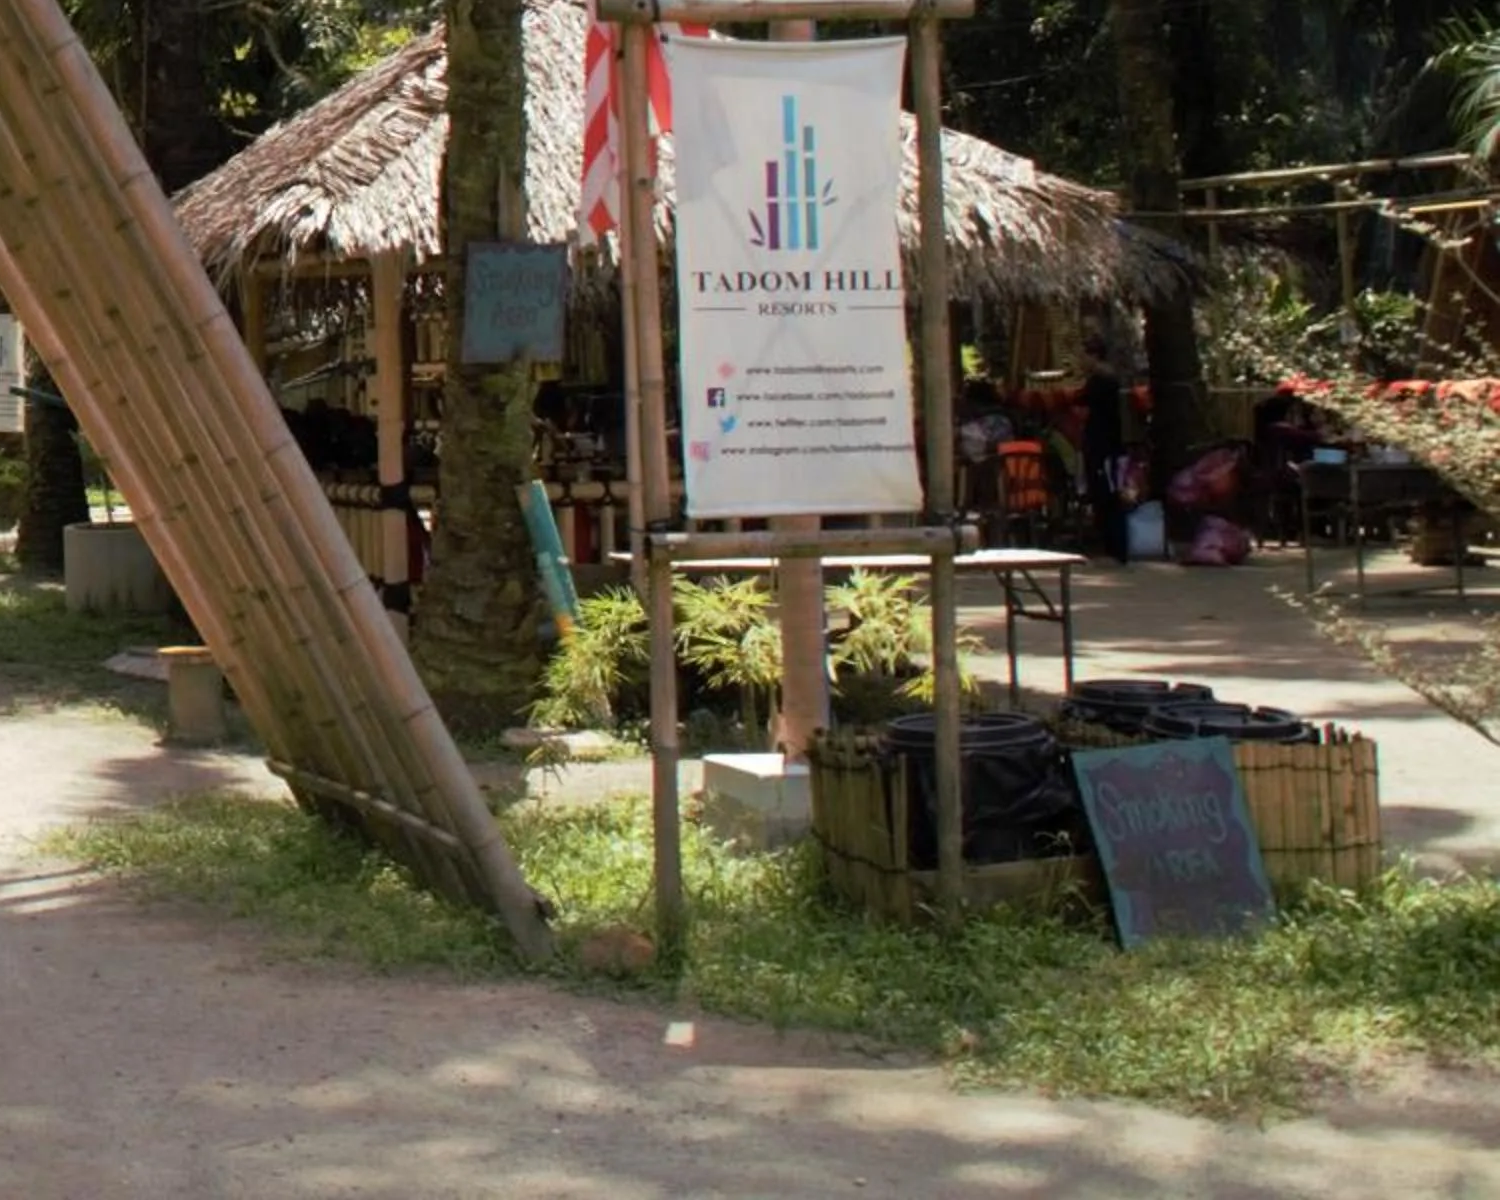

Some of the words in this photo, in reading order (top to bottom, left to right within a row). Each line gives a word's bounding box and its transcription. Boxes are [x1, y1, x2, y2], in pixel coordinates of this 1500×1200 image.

[692, 271, 812, 293] TADOM
[824, 270, 902, 291] HILL
[758, 303, 838, 316] RESORTS
